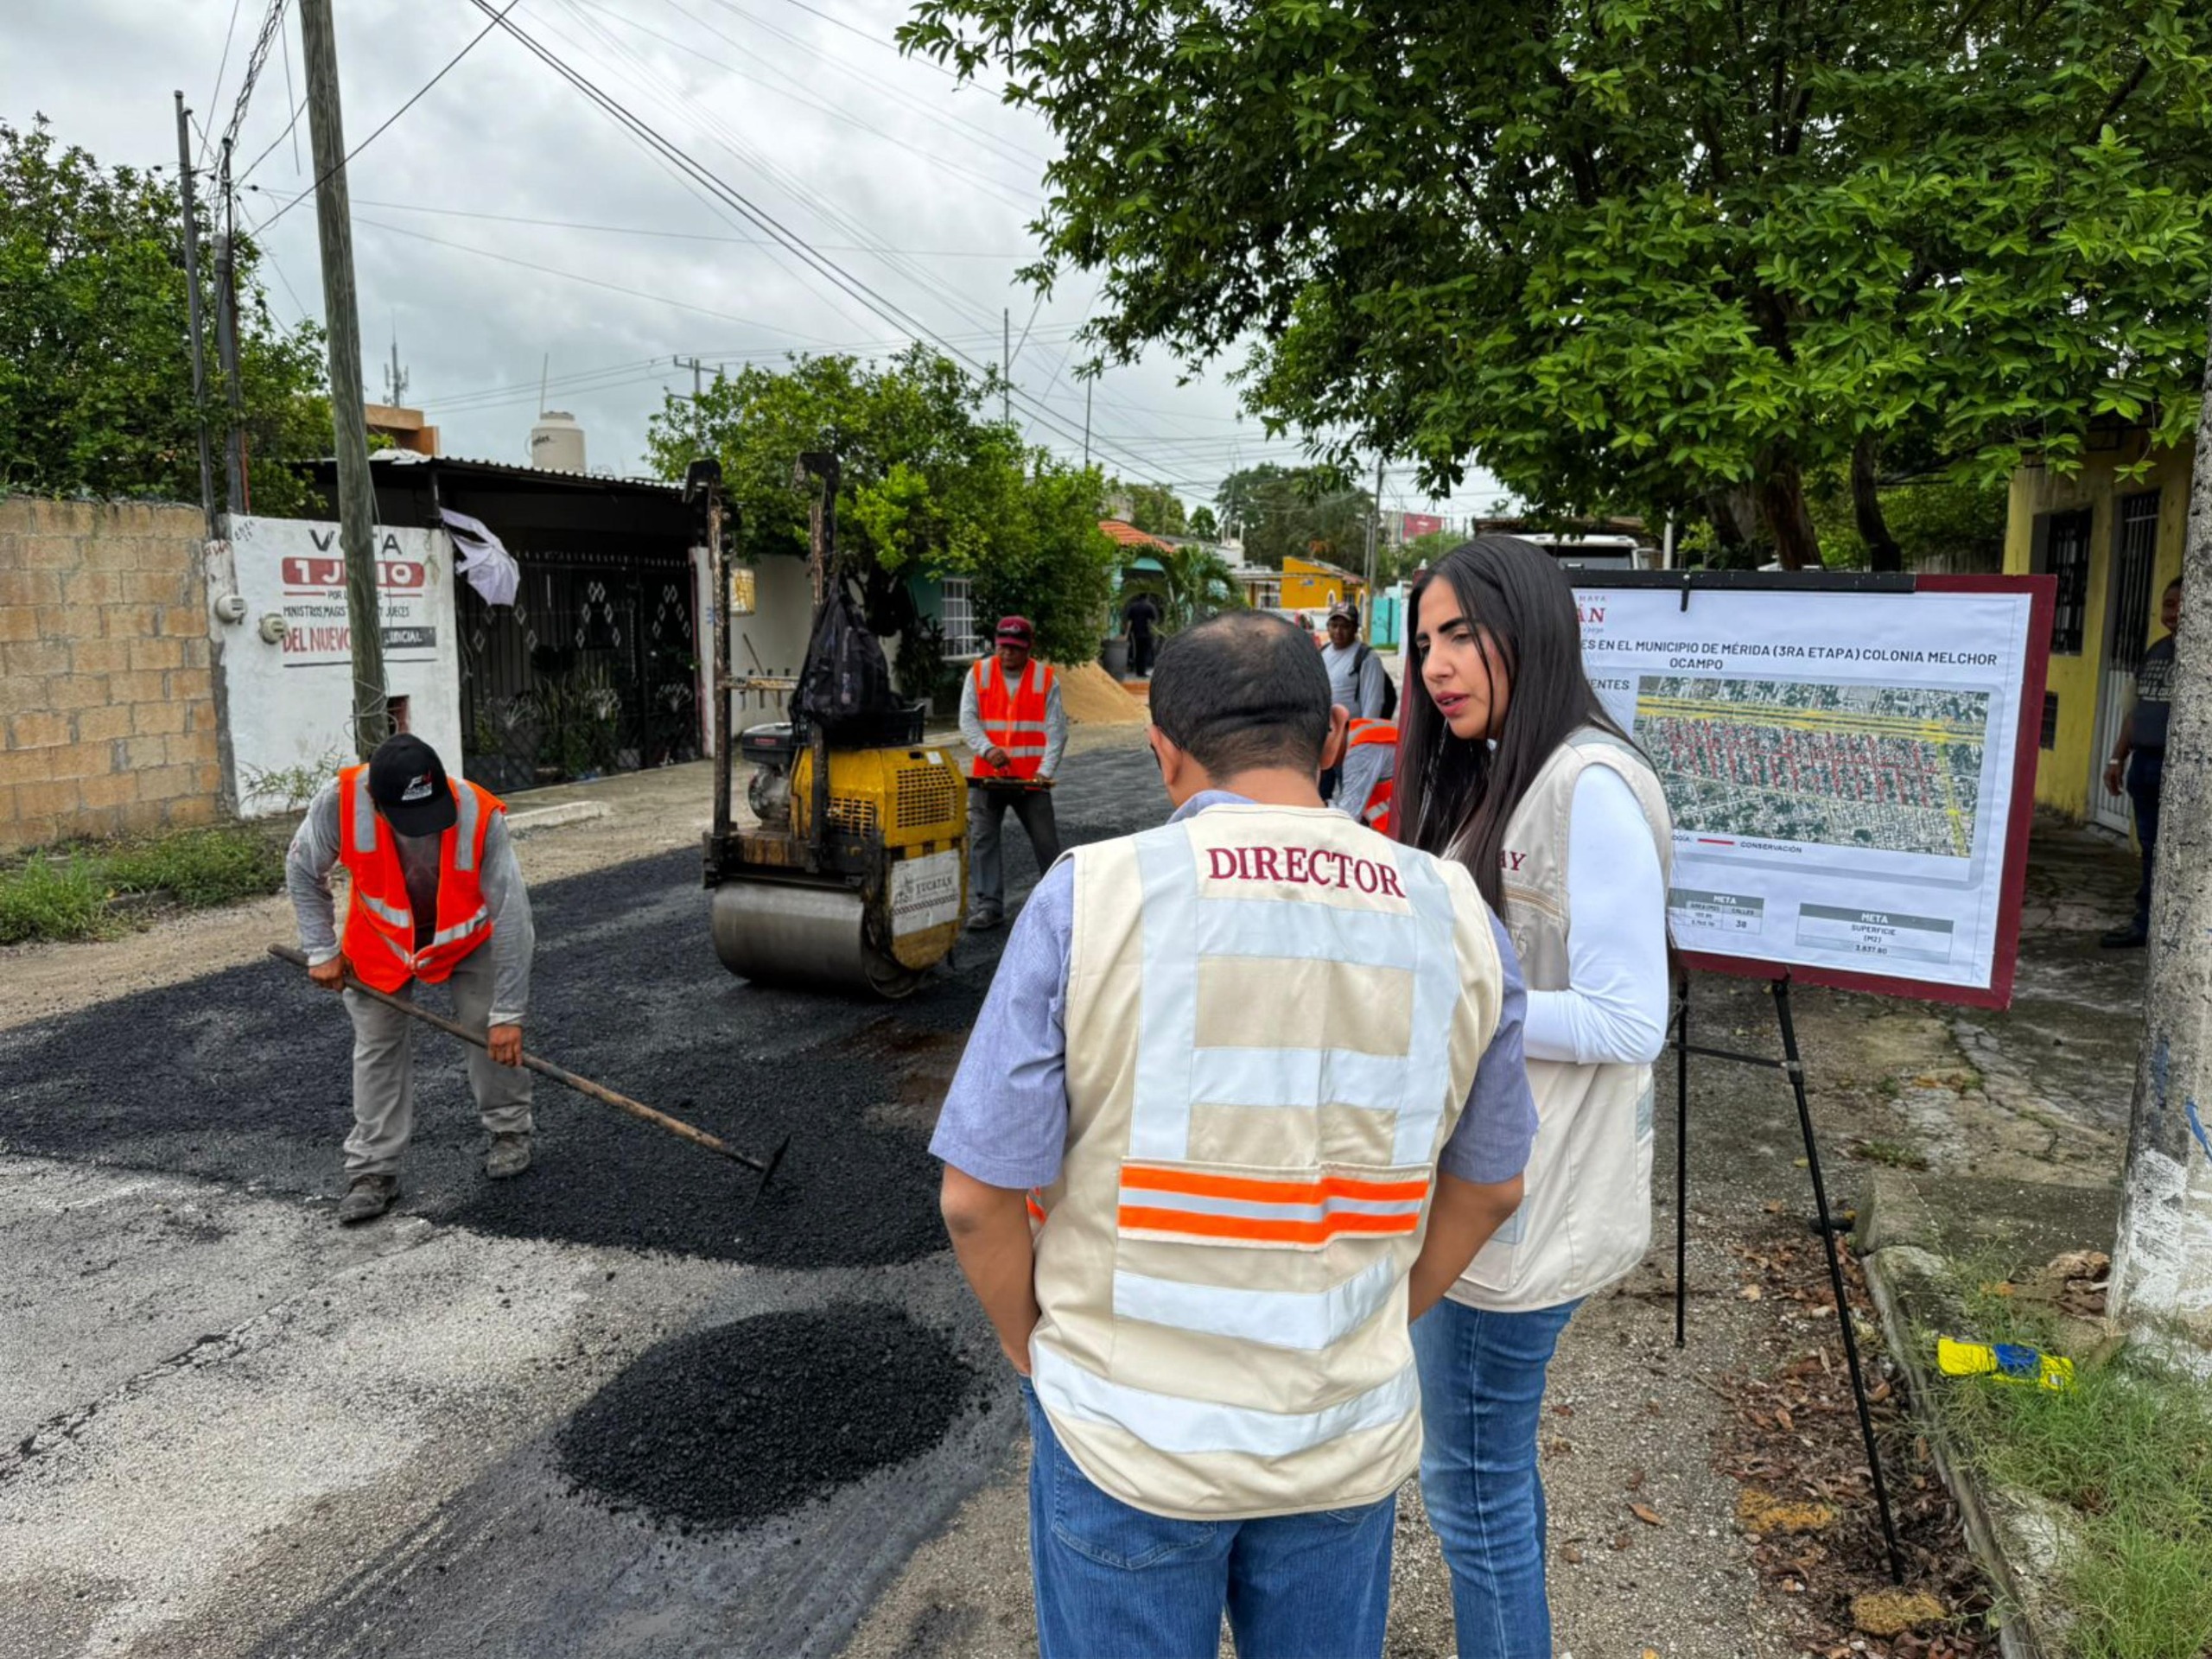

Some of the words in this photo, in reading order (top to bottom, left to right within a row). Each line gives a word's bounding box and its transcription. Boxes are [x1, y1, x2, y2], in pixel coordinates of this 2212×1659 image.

[308, 529, 403, 556] VA
[294, 560, 310, 584] 1
[321, 562, 412, 585] JIO
[283, 626, 308, 653] DEL
[1599, 640, 1615, 651] EN
[1618, 640, 1633, 652] EL
[1636, 641, 1699, 654] MUNICIPIO
[1701, 643, 1720, 655] DE
[1721, 641, 1770, 657] MÉRIDA
[1772, 645, 1805, 659] (3RA
[1808, 646, 1860, 661] ETAPA)
[1862, 648, 1924, 663] COLONIA
[1927, 651, 1998, 666] MELCHOR
[1669, 658, 1724, 671] OCAMPO
[1205, 846, 1407, 899] DIRECTOR
[1713, 895, 1737, 905] META
[1852, 924, 1896, 937] SUPERFICIE
[1861, 912, 1888, 925] META
